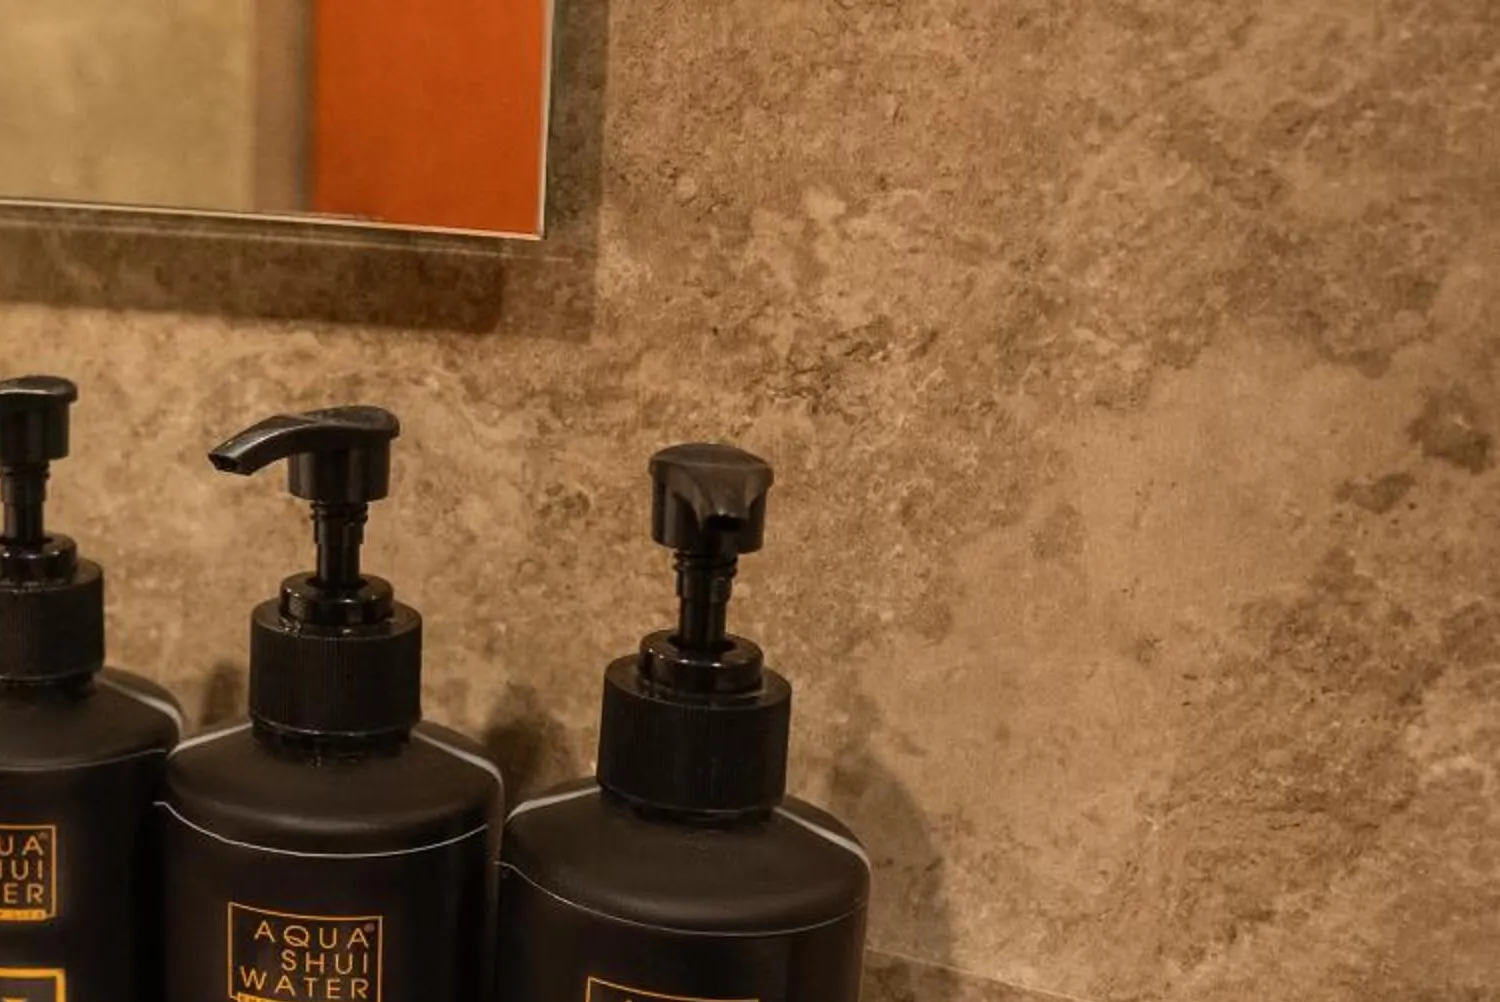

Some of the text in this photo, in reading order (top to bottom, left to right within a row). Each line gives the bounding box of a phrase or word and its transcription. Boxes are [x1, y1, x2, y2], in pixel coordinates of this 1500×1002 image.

[254, 920, 369, 949] AQUA
[281, 950, 368, 975] SHUI
[239, 965, 369, 999] WATER
